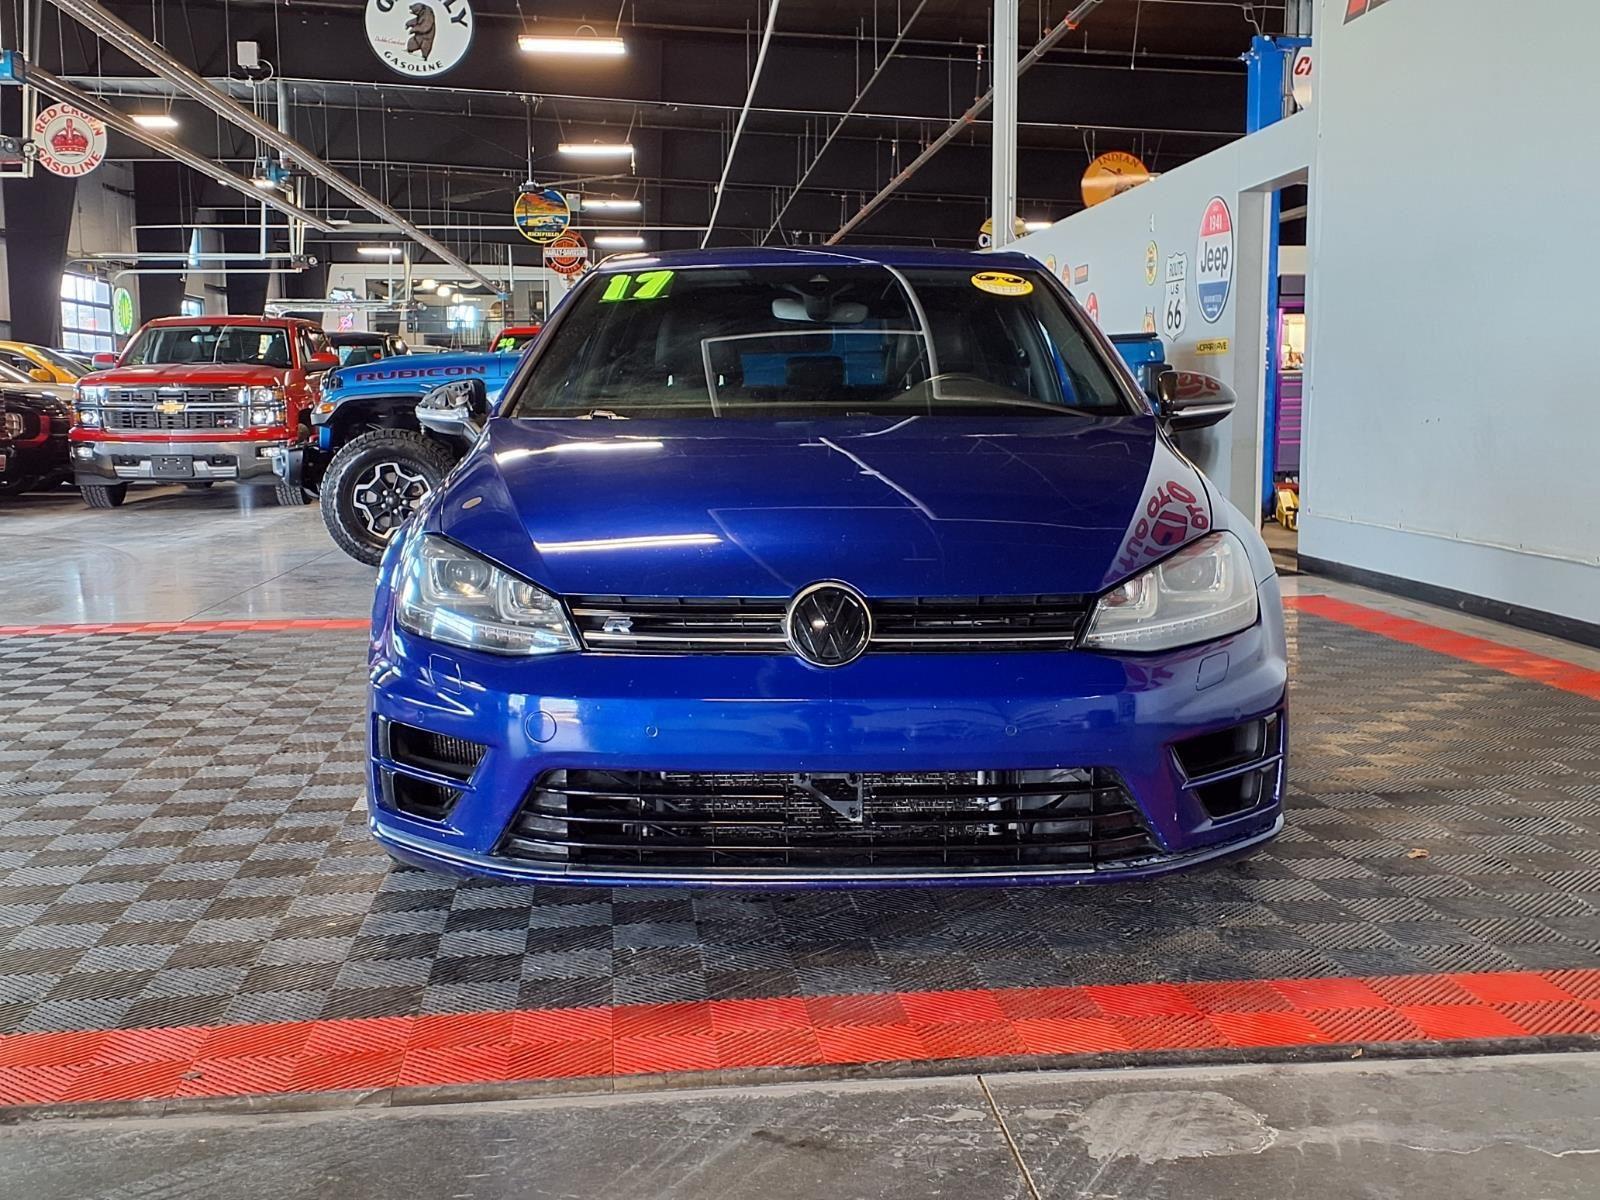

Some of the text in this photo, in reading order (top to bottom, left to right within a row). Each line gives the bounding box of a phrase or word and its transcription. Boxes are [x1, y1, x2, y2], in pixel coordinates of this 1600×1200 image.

[384, 51, 443, 72] GASOLINE
[34, 108, 57, 133] RED
[38, 147, 102, 175] GASOLINE
[1097, 153, 1140, 168] INDIAN
[1209, 214, 1223, 232] 1941
[1169, 261, 1184, 277] ROUTE
[1200, 241, 1229, 278] Jeep
[602, 270, 675, 300] 17
[1166, 298, 1182, 330] 66
[497, 337, 515, 348] 20
[355, 365, 486, 382] RUBICON
